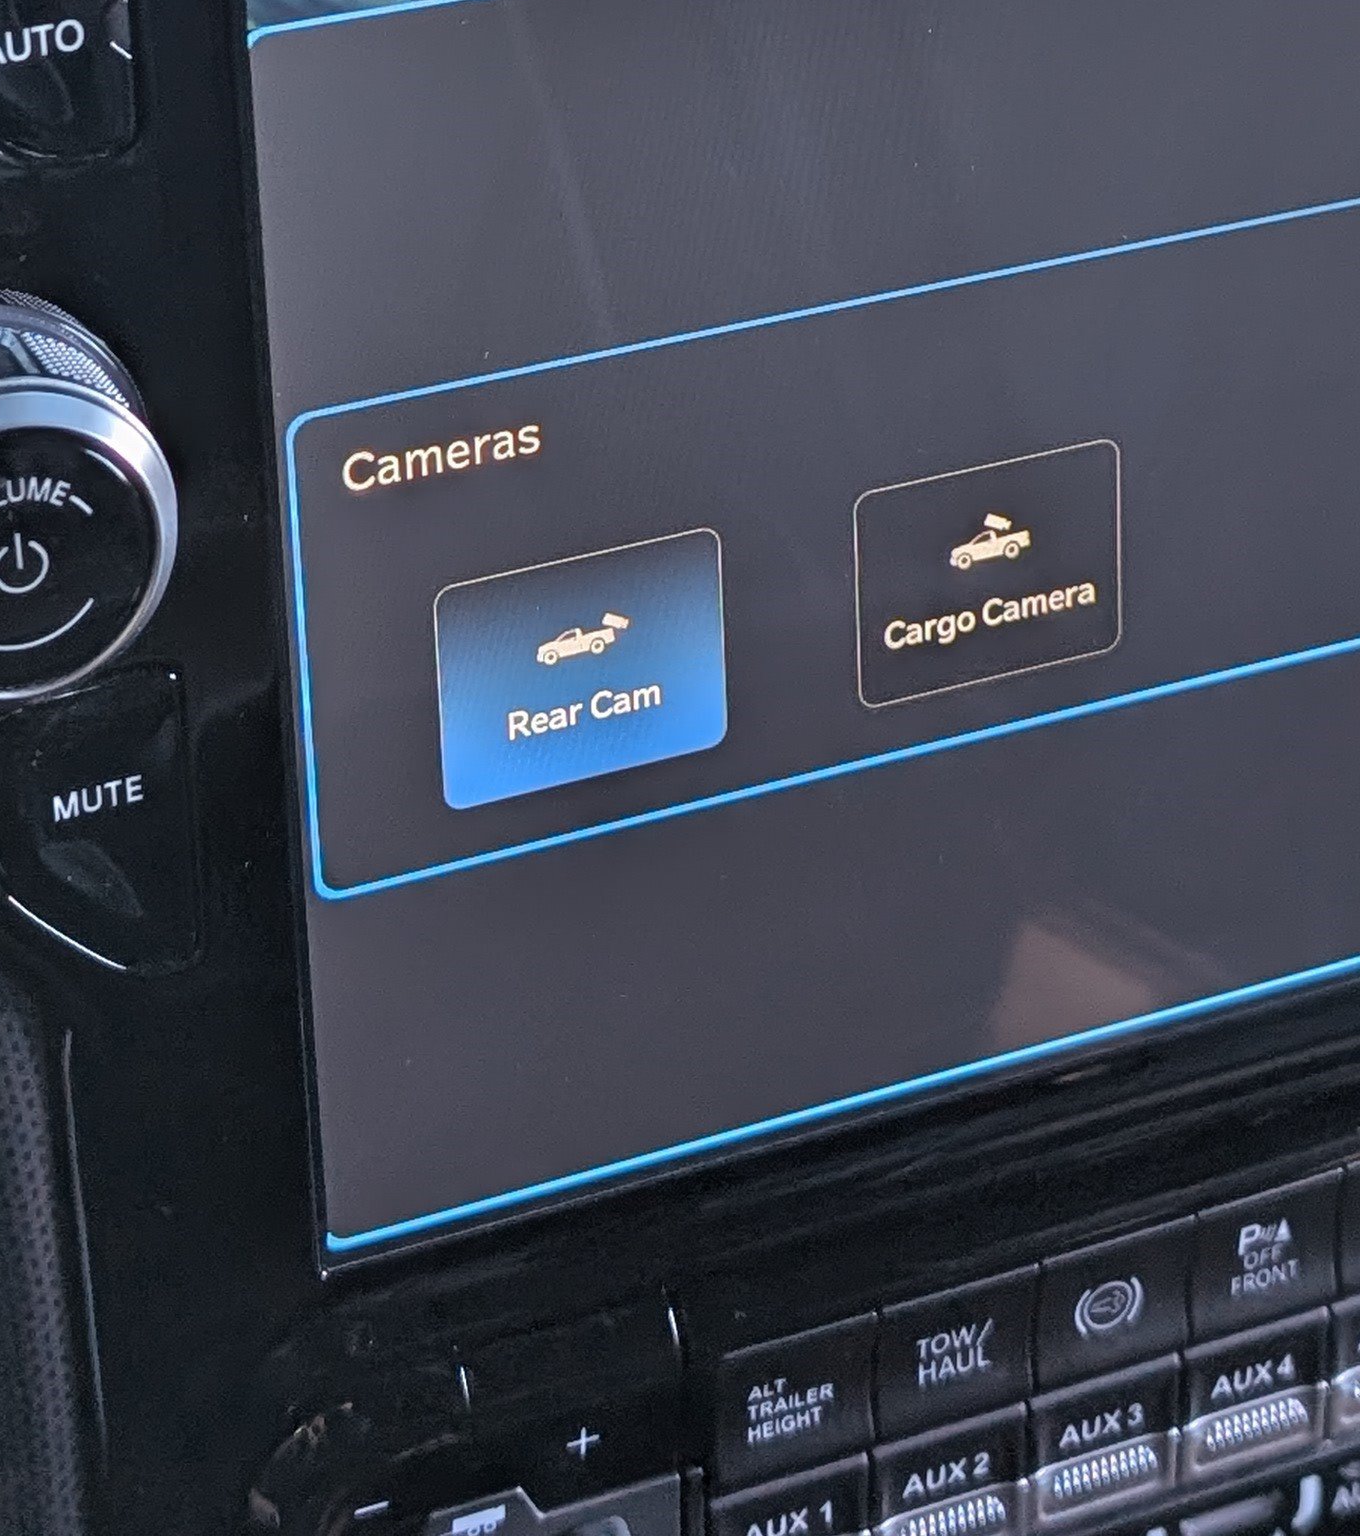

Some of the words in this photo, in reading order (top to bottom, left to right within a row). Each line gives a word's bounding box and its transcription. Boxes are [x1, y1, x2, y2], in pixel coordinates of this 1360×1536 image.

[341, 423, 542, 493] Cameras
[883, 611, 977, 650] Cargo
[981, 582, 1096, 627] Camera
[507, 701, 584, 742] Rear
[589, 684, 662, 720] Cam
[53, 774, 144, 823] MUTE
[1231, 1259, 1299, 1296] FRONT
[1243, 1244, 1283, 1271] OFF
[916, 1317, 993, 1360] TOW/
[917, 1346, 991, 1387] HAUL
[1211, 1360, 1273, 1400] AUX
[1276, 1353, 1296, 1379] 4
[747, 1378, 787, 1402] ALT
[747, 1382, 834, 1421] TRAILER
[747, 1406, 824, 1446] HEIGHT
[1059, 1409, 1122, 1449] AUX
[1125, 1402, 1145, 1428] 3
[902, 1457, 968, 1499] AUX
[972, 1452, 990, 1476] 2
[819, 1499, 834, 1526] 1
